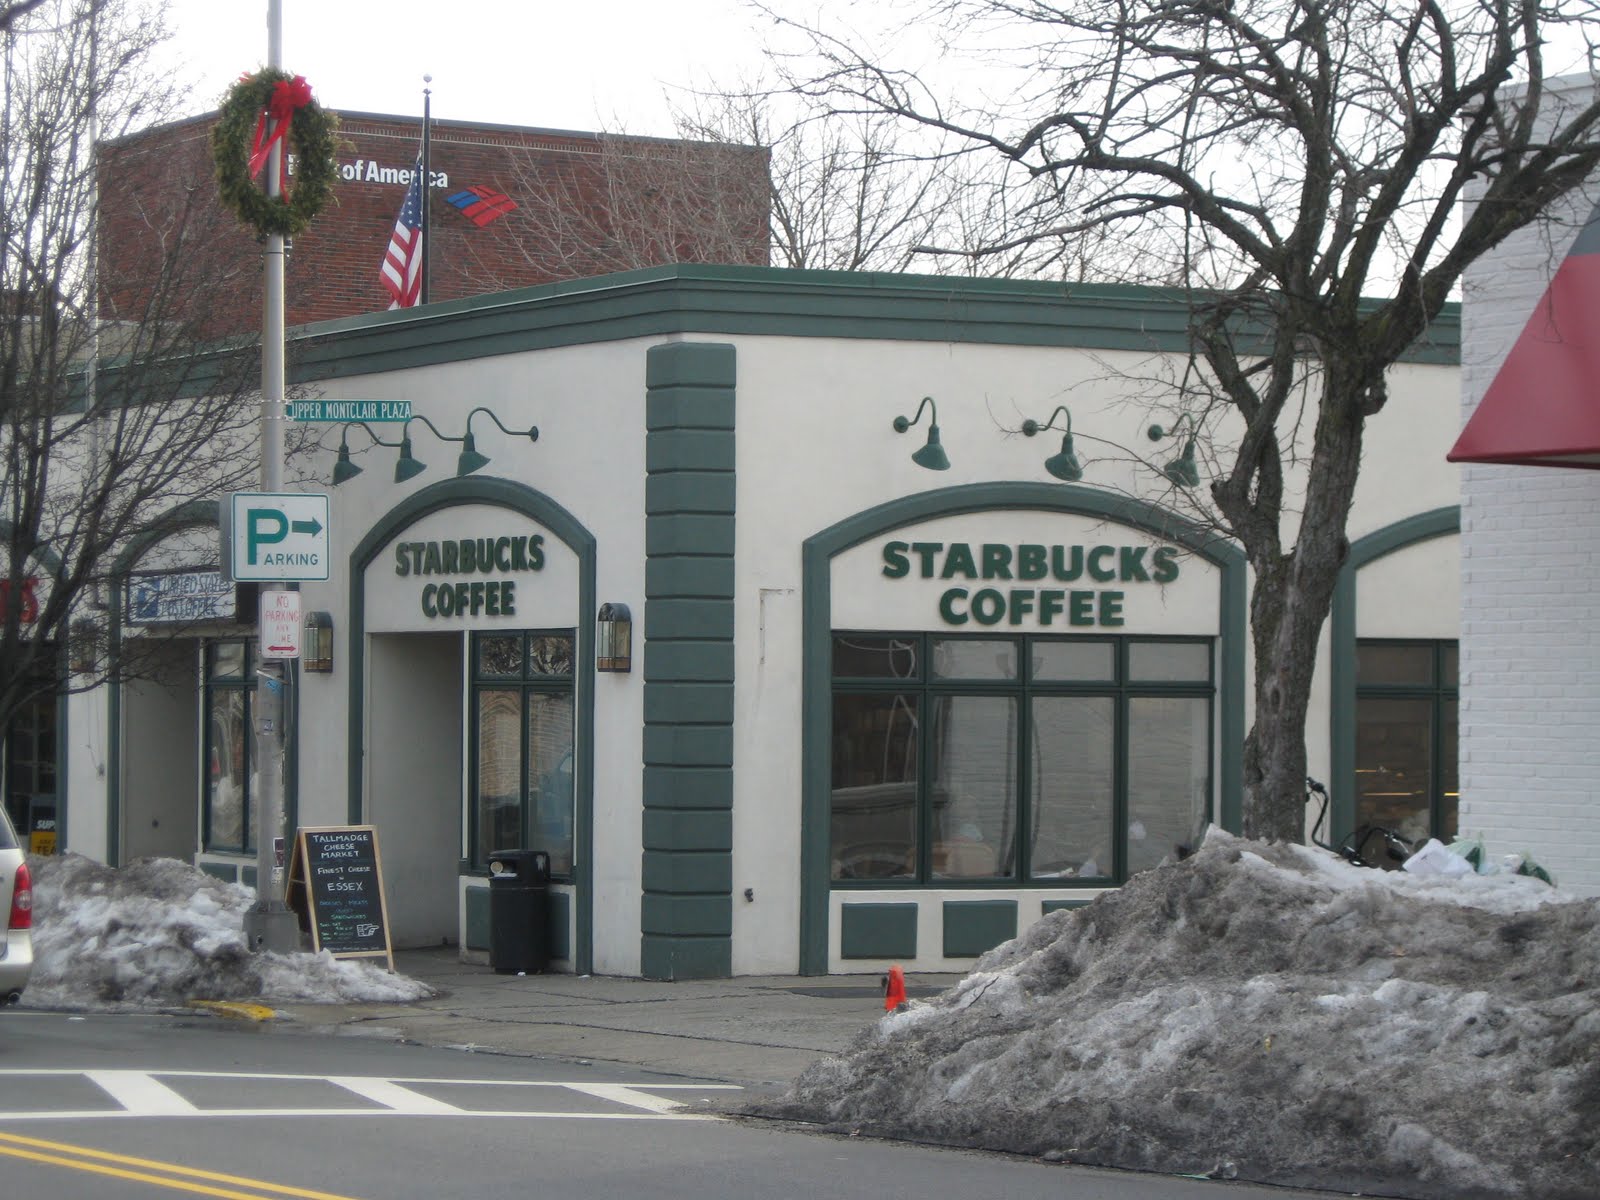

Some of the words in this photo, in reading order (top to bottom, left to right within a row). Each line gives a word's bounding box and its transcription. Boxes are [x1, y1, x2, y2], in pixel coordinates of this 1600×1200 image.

[342, 159, 364, 181] of
[292, 402, 321, 419] UPPER
[326, 402, 377, 419] MONTCLAIR
[381, 402, 412, 419] PLAZA
[395, 534, 545, 576] STARBUCKS
[882, 541, 1180, 583] STARBUCKS
[276, 595, 289, 608] NO
[421, 581, 515, 618] COFFEE
[939, 588, 1125, 626] COFFEE
[265, 610, 300, 623] PARKING
[312, 834, 369, 843] TALLMADGE
[321, 850, 359, 859] MARKET
[324, 843, 355, 851] CHEESE
[327, 881, 363, 892] ESSEX
